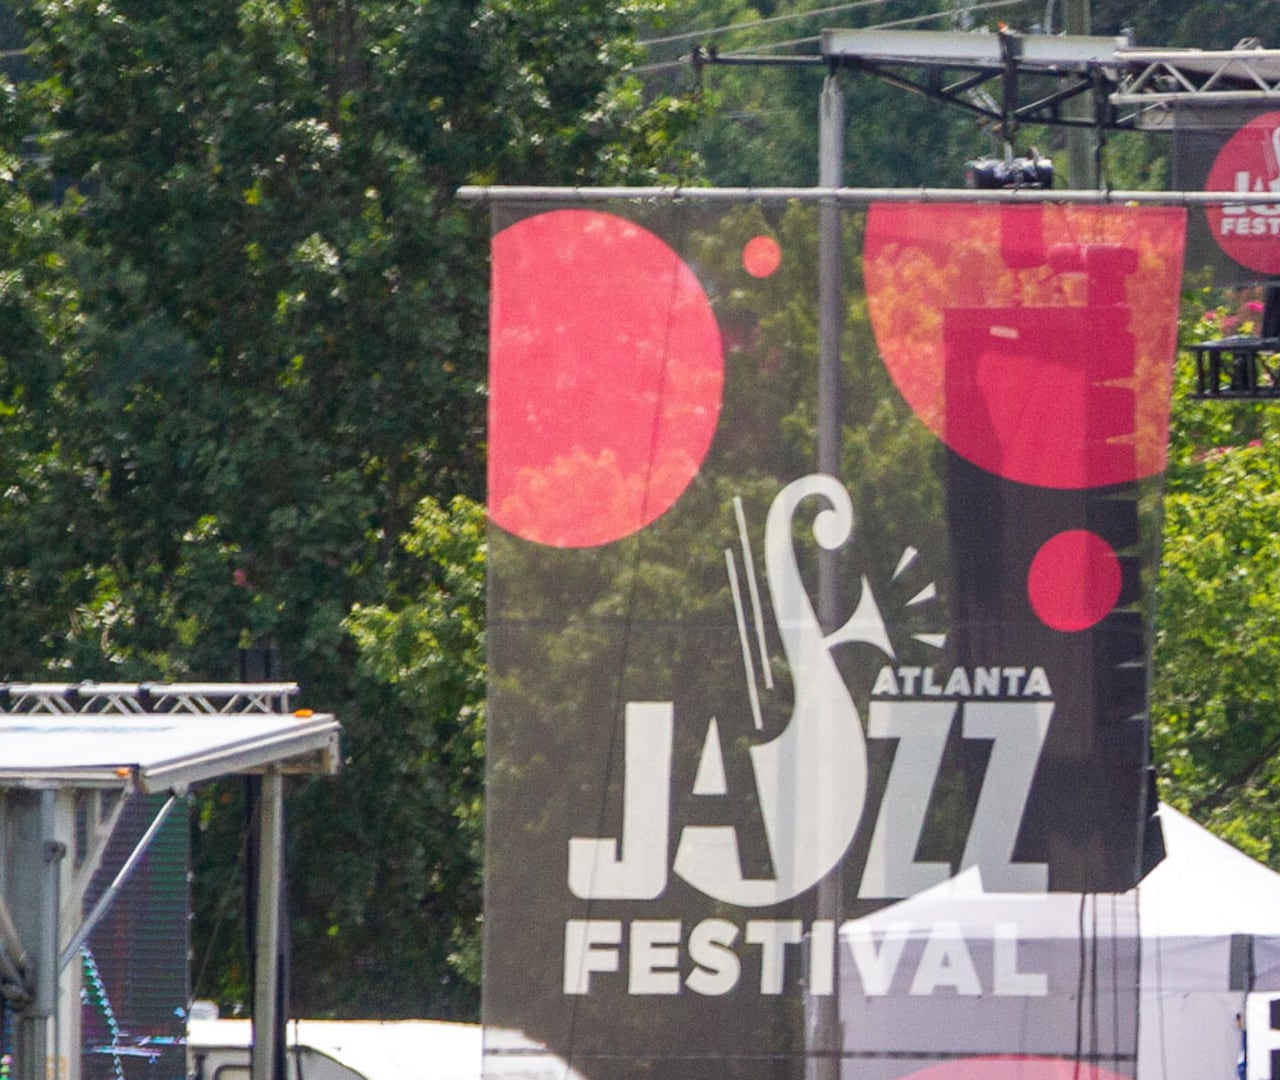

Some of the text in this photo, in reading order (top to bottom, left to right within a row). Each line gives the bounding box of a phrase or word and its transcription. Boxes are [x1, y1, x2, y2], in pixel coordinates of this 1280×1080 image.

[872, 667, 1053, 697] ATLANTA
[568, 600, 1056, 907] JAZZ
[563, 919, 1049, 996] FESTIVAL
